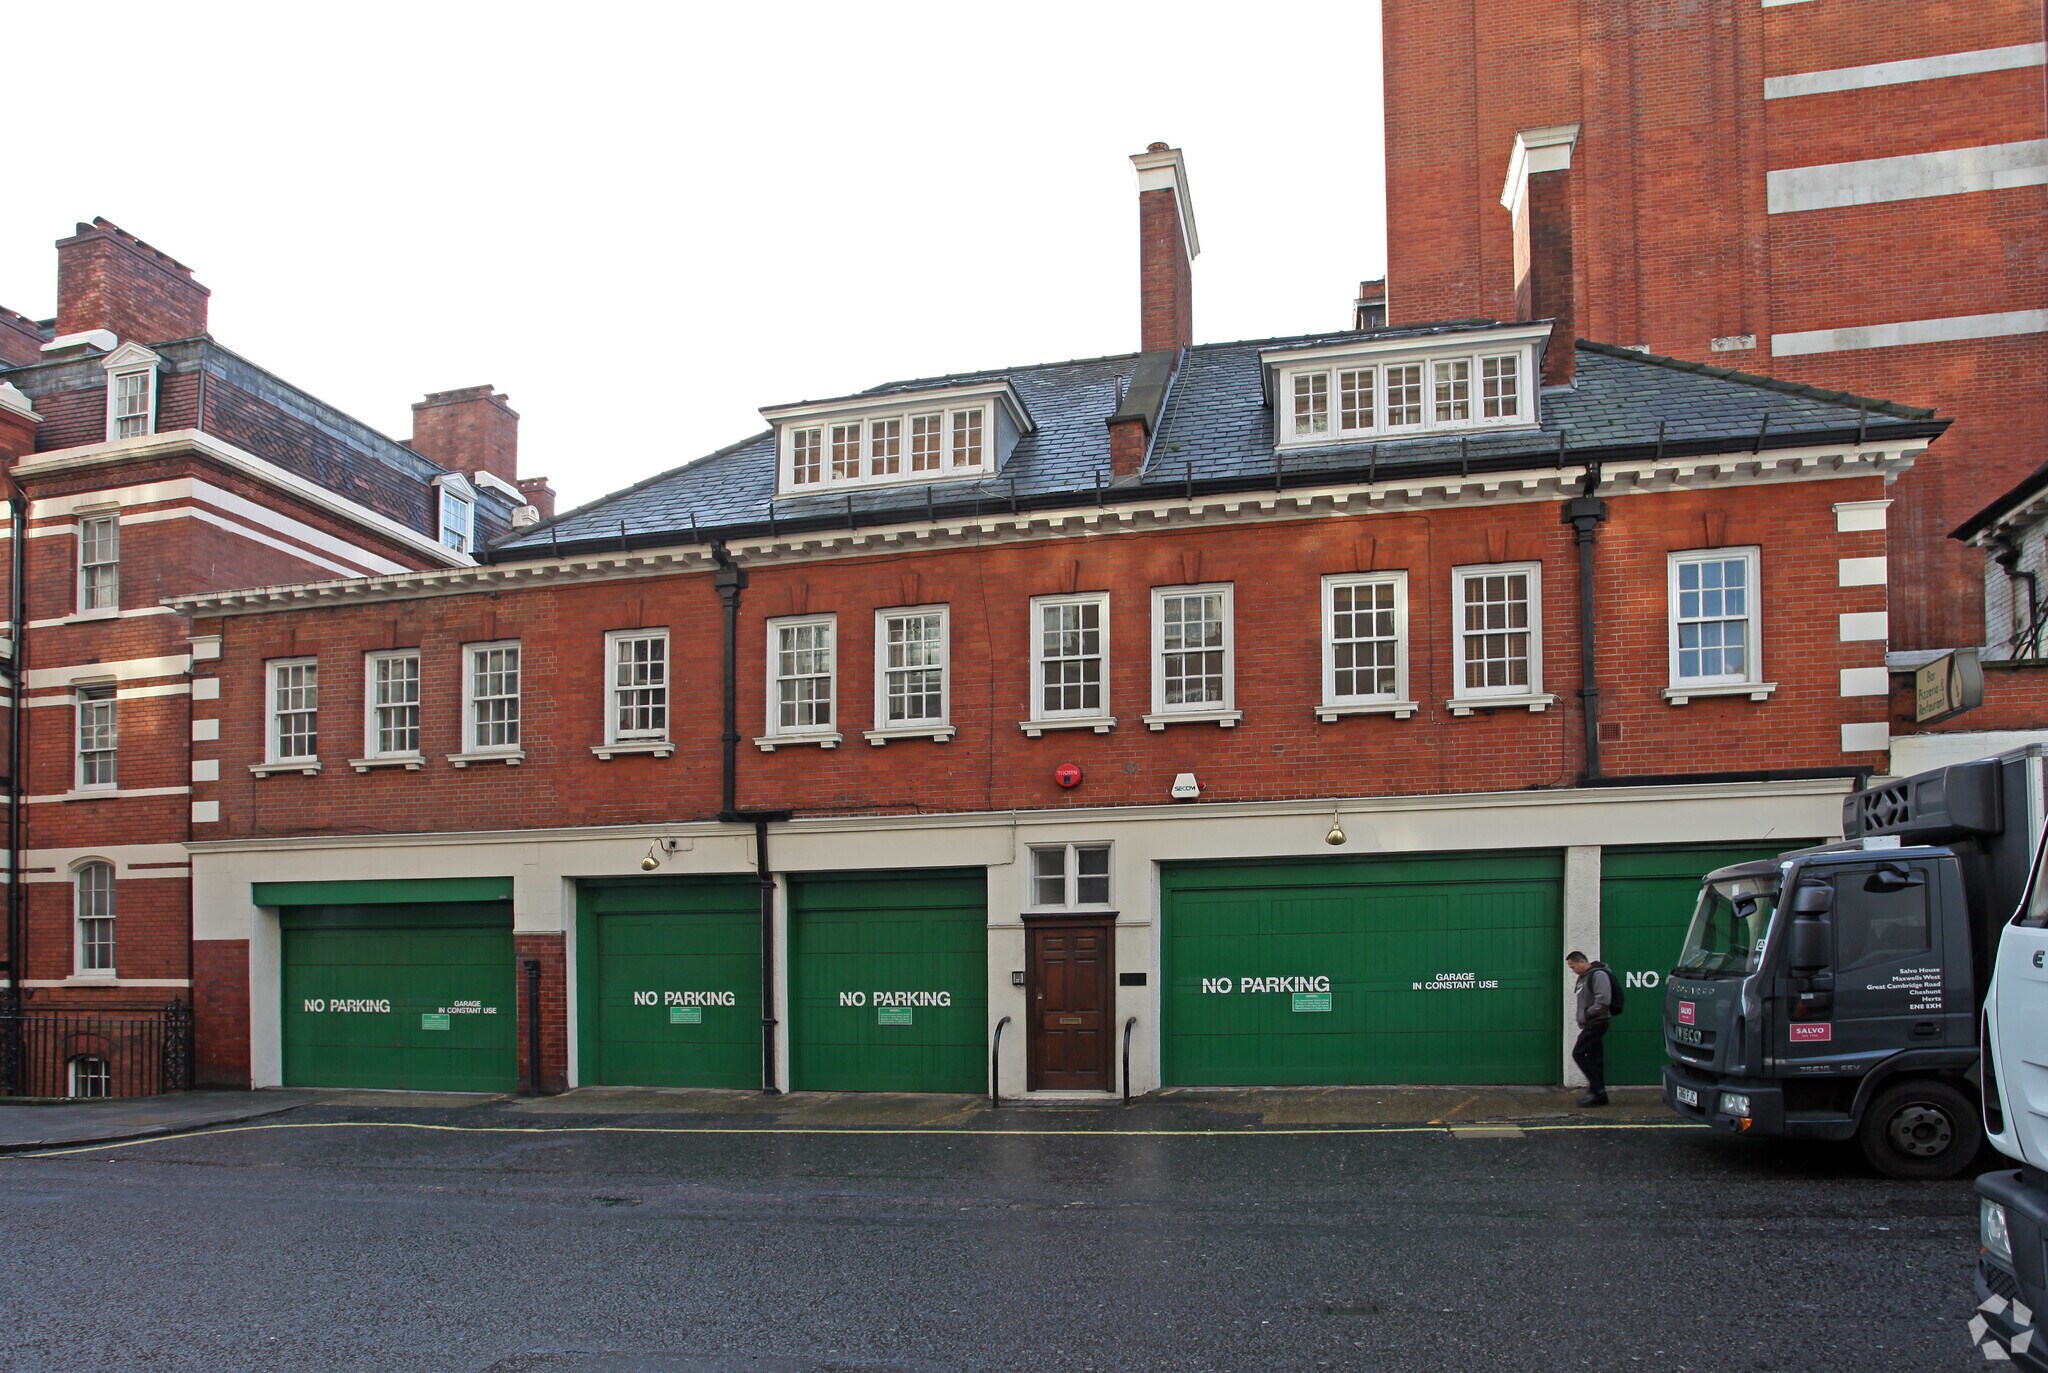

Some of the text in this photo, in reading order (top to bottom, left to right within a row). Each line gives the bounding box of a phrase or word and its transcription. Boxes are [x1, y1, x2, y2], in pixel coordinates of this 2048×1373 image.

[1927, 670, 1936, 683] Bar
[1919, 685, 1939, 701] Pizzeria
[1940, 678, 1945, 692] &
[1919, 694, 1945, 716] Restaurant
[1435, 972, 1475, 981] GARAGE
[1625, 970, 1660, 988] NO
[1202, 976, 1330, 994] NO PARKING
[1412, 980, 1499, 990] IN CONSTANT USE
[1886, 982, 1923, 990] Cambridge
[304, 998, 391, 1013] NO PARKING
[453, 1000, 482, 1008] GARAGE
[633, 991, 736, 1006] NO PARKING
[839, 991, 951, 1007] NO PARKING
[446, 1007, 482, 1015] CONSTANT
[1680, 1006, 1692, 1015] SALVO
[1675, 1025, 1702, 1045] IVECO
[1796, 1027, 1825, 1035] SALVO
